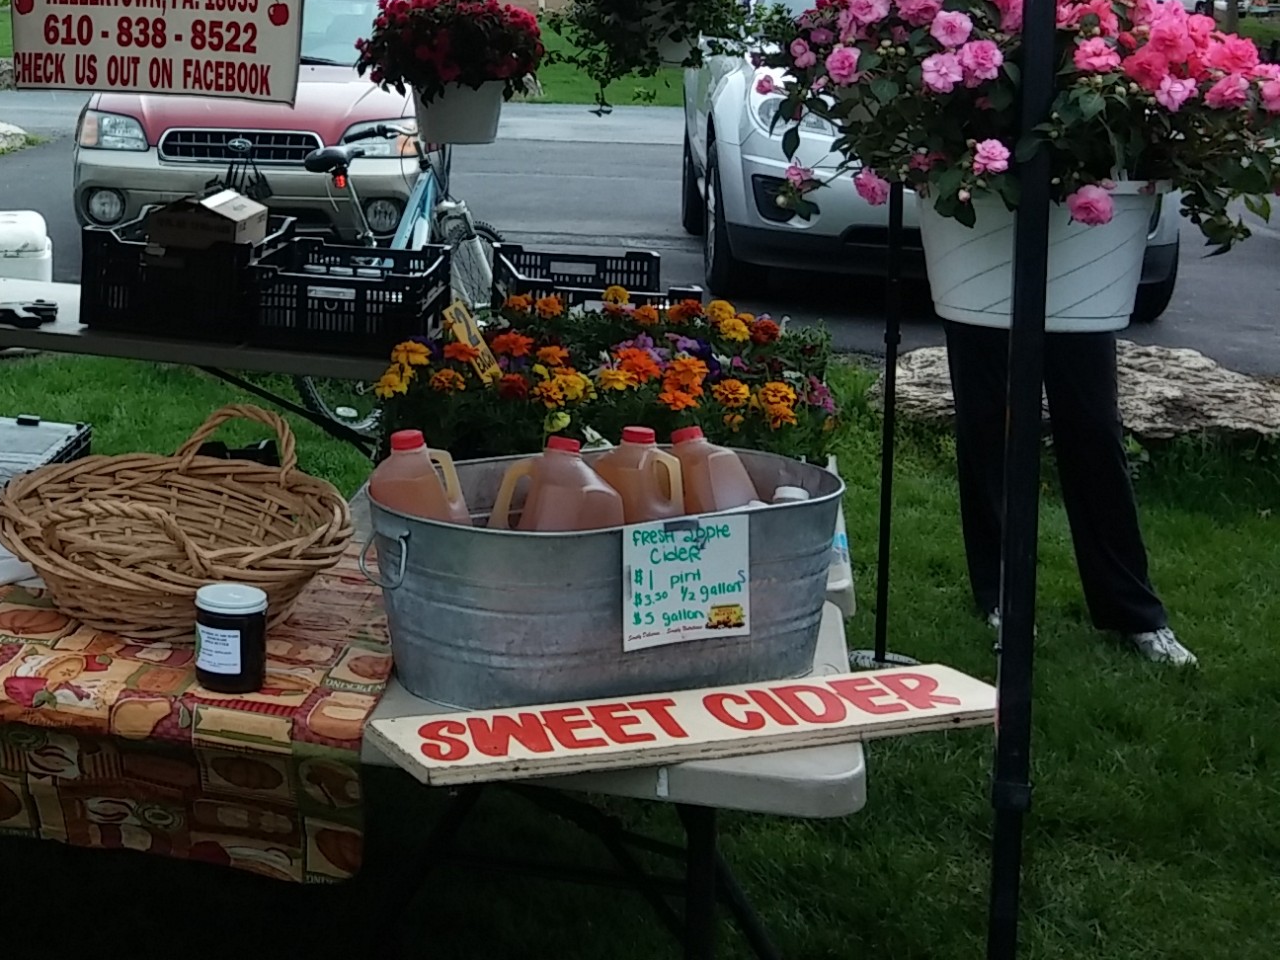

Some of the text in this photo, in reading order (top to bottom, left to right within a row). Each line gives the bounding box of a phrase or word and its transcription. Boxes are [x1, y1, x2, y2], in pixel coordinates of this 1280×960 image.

[44, 14, 93, 45] 610
[117, 16, 167, 48] 838
[191, 19, 257, 54] 8522
[14, 52, 271, 96] CHECK US OUT ON FACEBOOK
[670, 569, 701, 589] pint
[662, 608, 705, 627] gallon
[418, 672, 962, 761] SWEET CIDER
